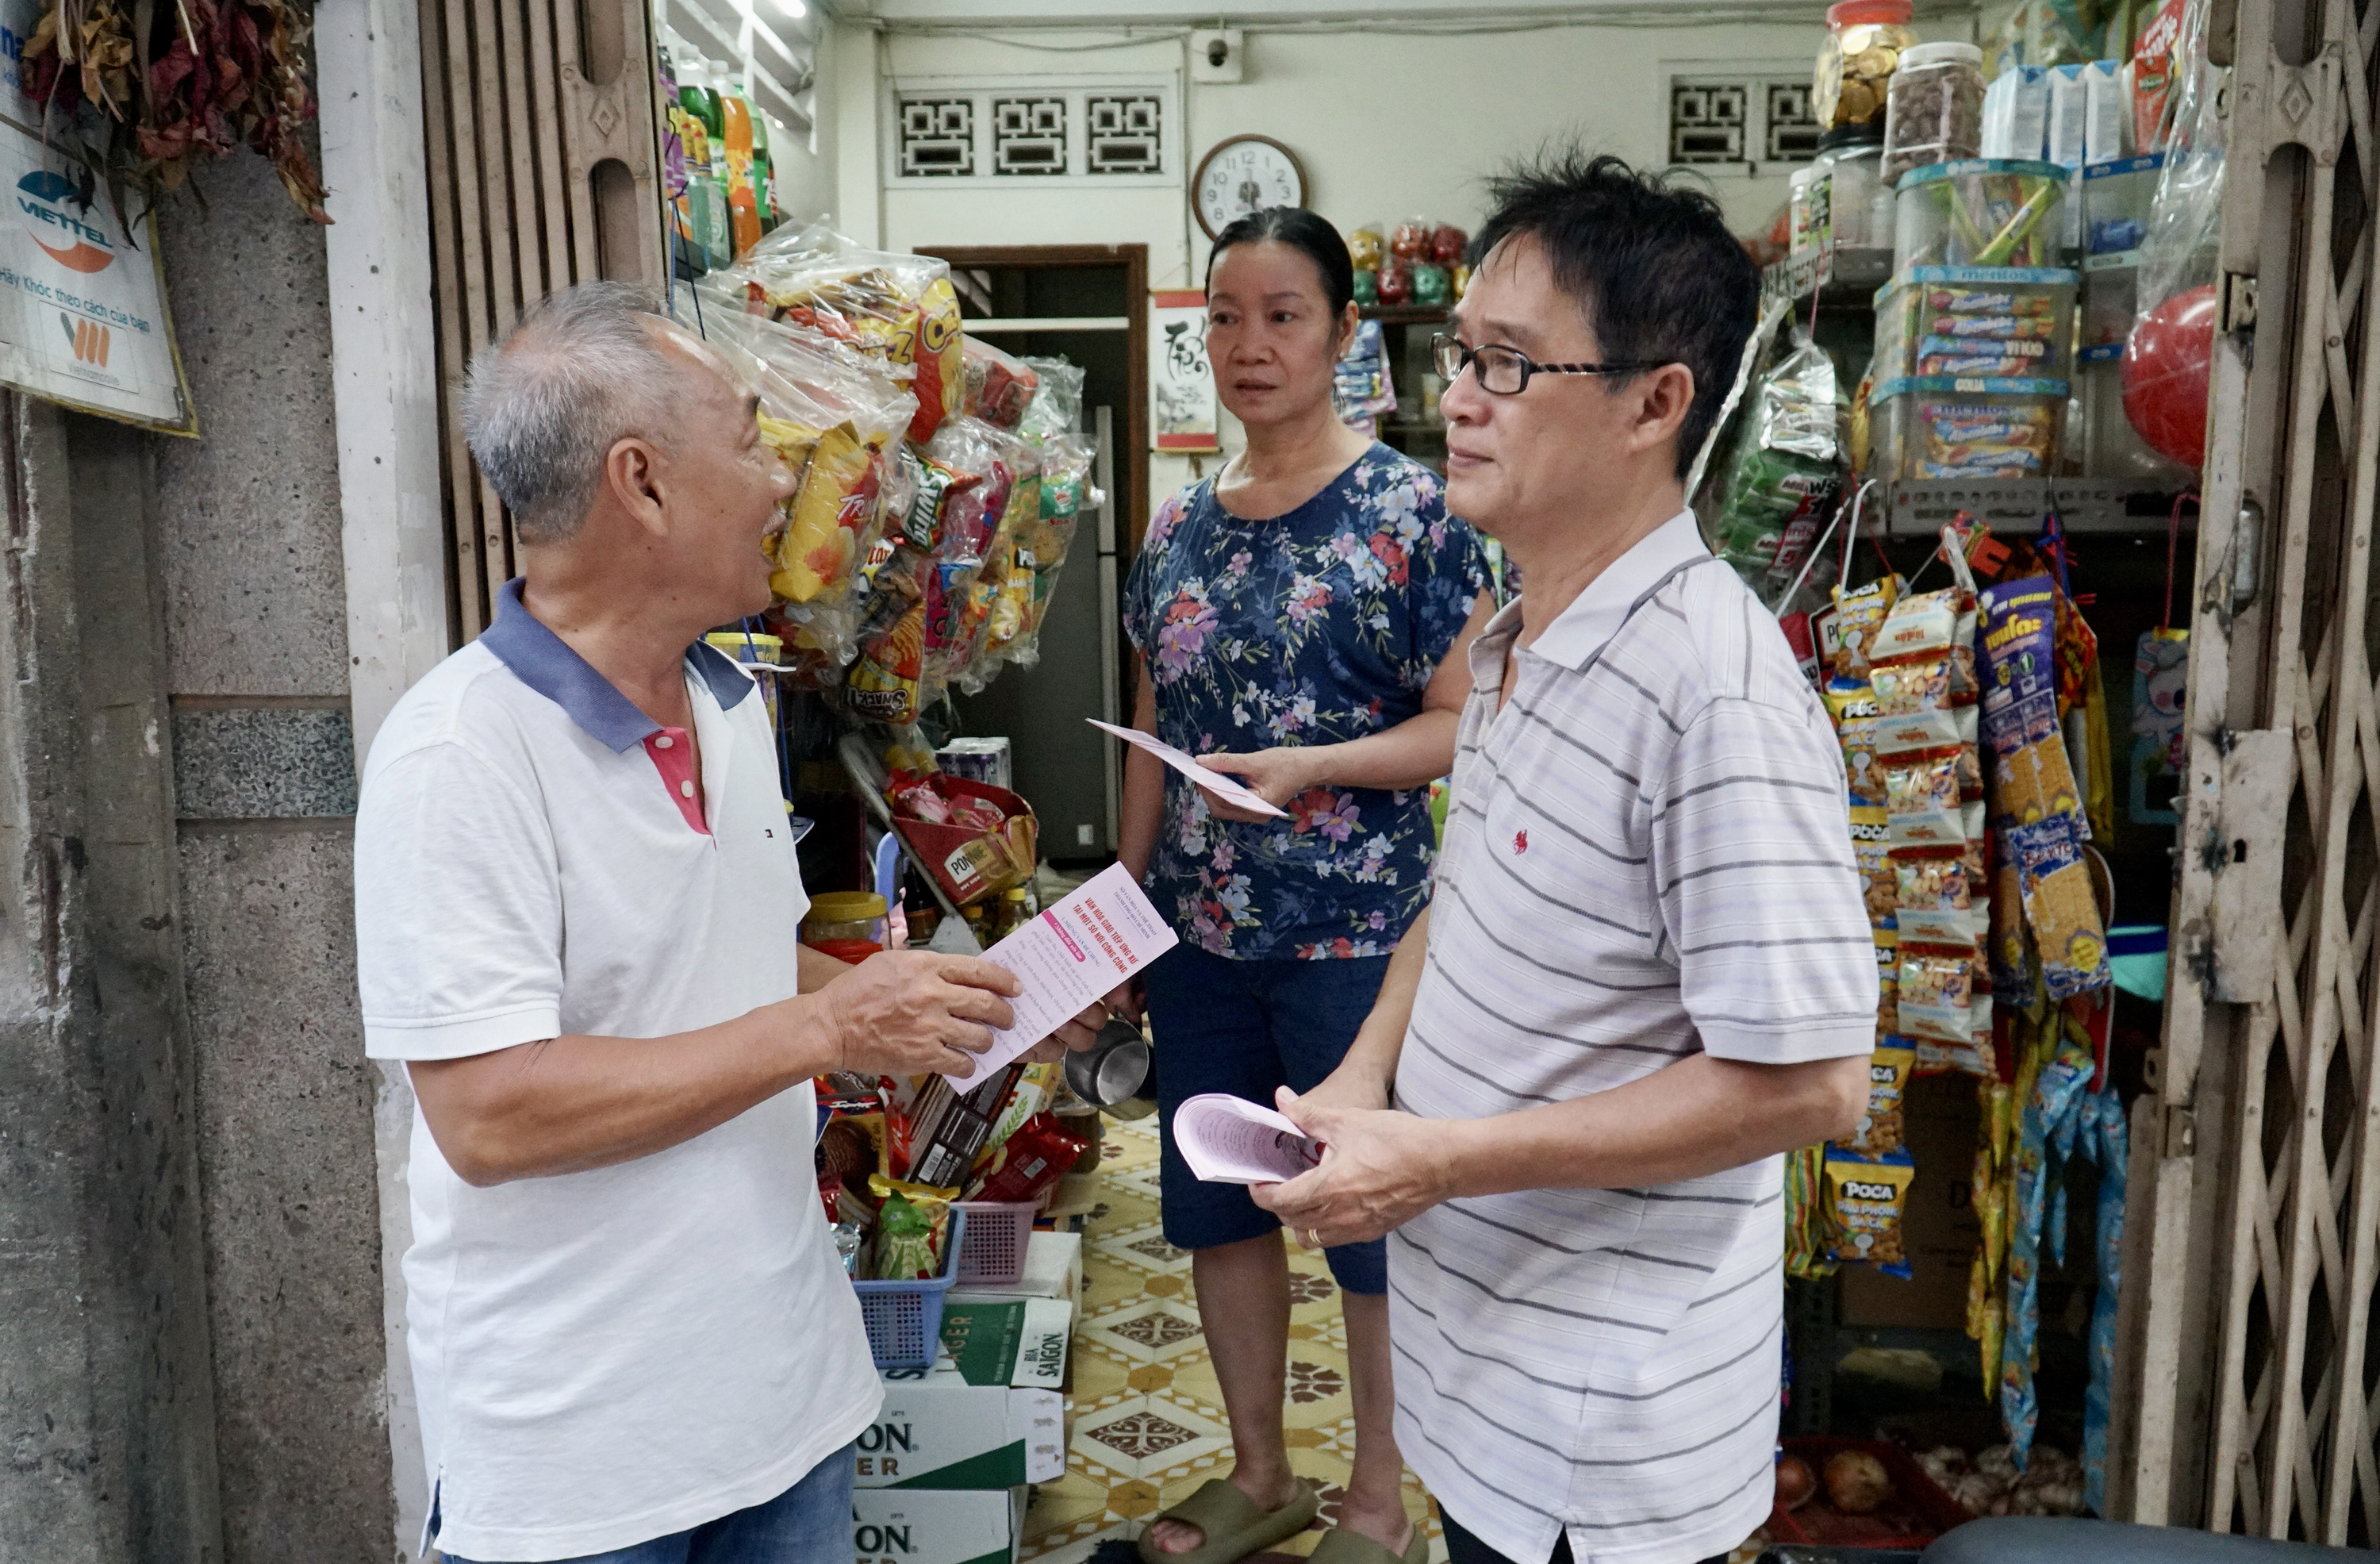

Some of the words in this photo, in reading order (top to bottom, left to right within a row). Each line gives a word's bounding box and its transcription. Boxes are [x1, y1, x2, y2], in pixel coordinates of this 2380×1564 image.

[1226, 157, 1237, 170] 11
[1241, 150, 1255, 164] 12
[1265, 156, 1270, 168] 1
[1213, 171, 1228, 185] 10
[1276, 169, 1285, 183] 2
[1207, 189, 1217, 202] 9
[1280, 185, 1291, 199] 3
[1214, 207, 1224, 221] 8
[17, 195, 113, 248] VIETTEL
[56, 288, 82, 308] theo
[83, 298, 108, 318] cách
[110, 305, 129, 325] của
[903, 471, 954, 547] Swing
[1845, 704, 1878, 718] POC
[1845, 1182, 1894, 1200] POCA
[935, 1316, 973, 1373] LAGER
[1036, 1332, 1065, 1378] SAIGON
